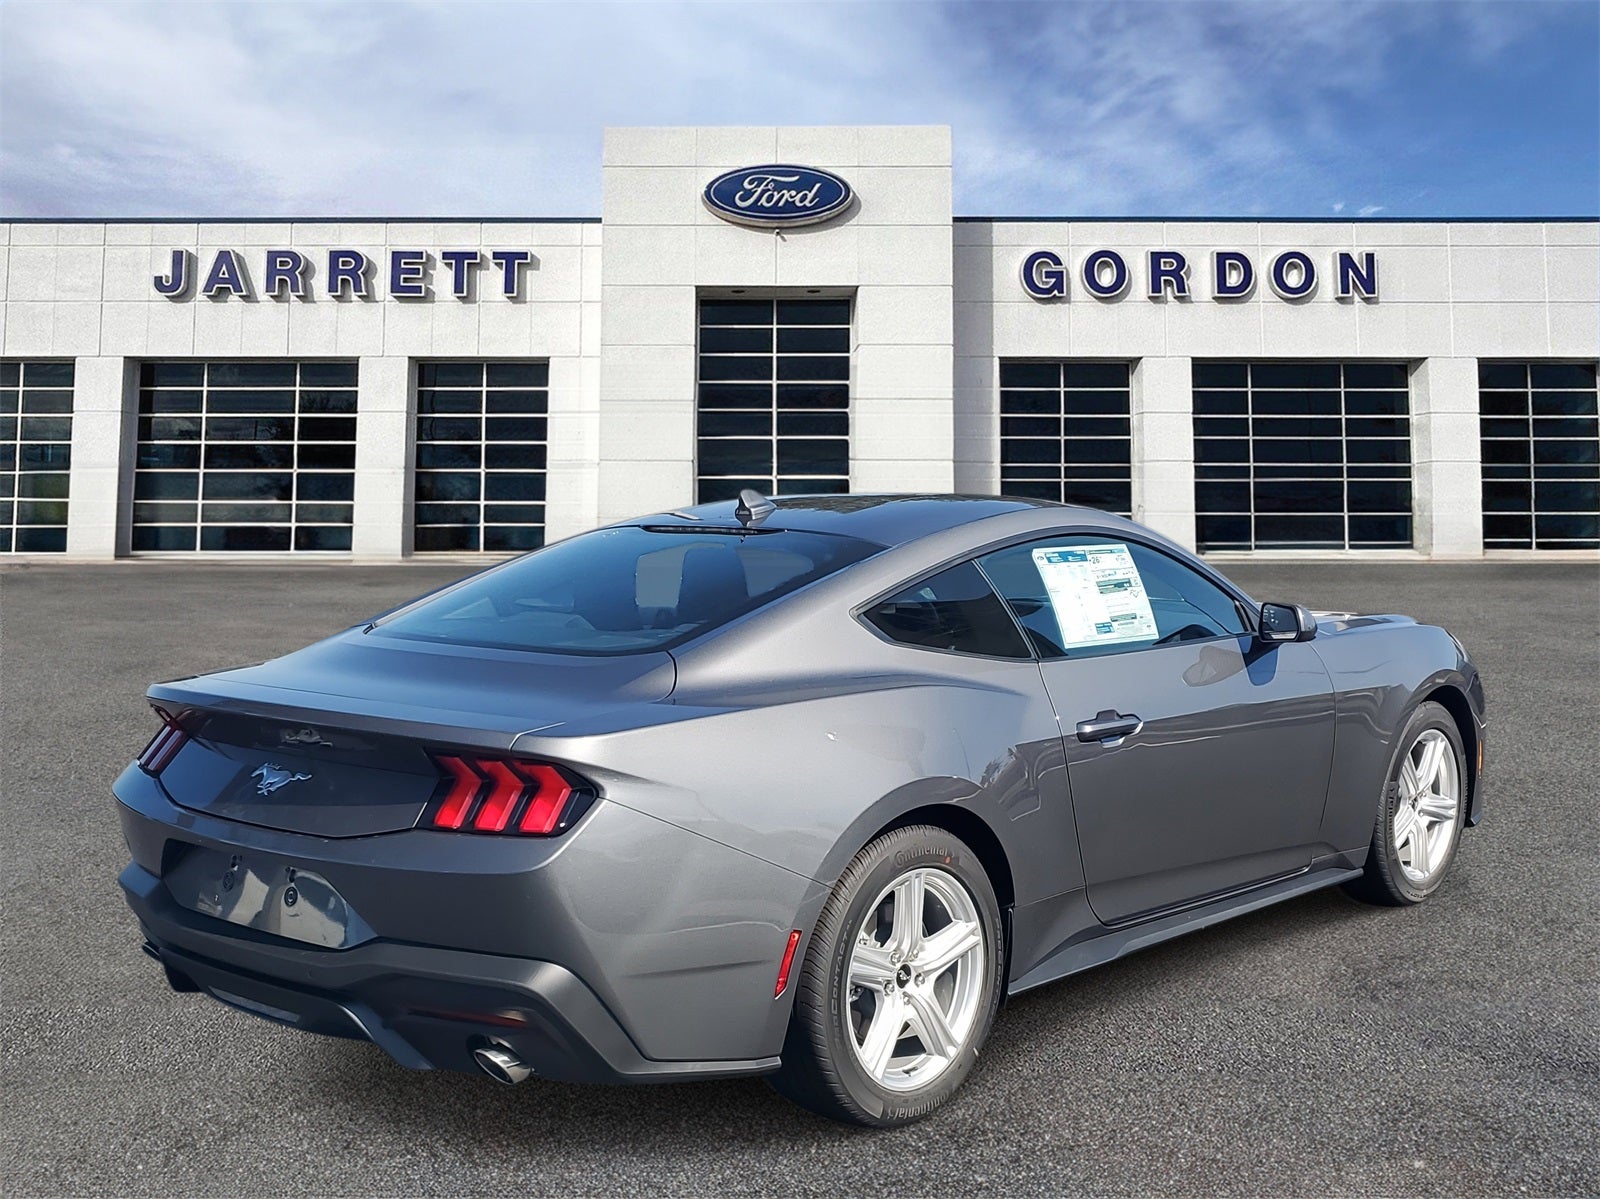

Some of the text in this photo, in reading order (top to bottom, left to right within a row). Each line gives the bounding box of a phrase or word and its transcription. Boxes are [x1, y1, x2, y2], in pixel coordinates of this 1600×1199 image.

[735, 174, 822, 207] Ford
[154, 248, 532, 298] JARRETT
[1020, 249, 1379, 298] GORDON
[894, 846, 948, 869] Continental
